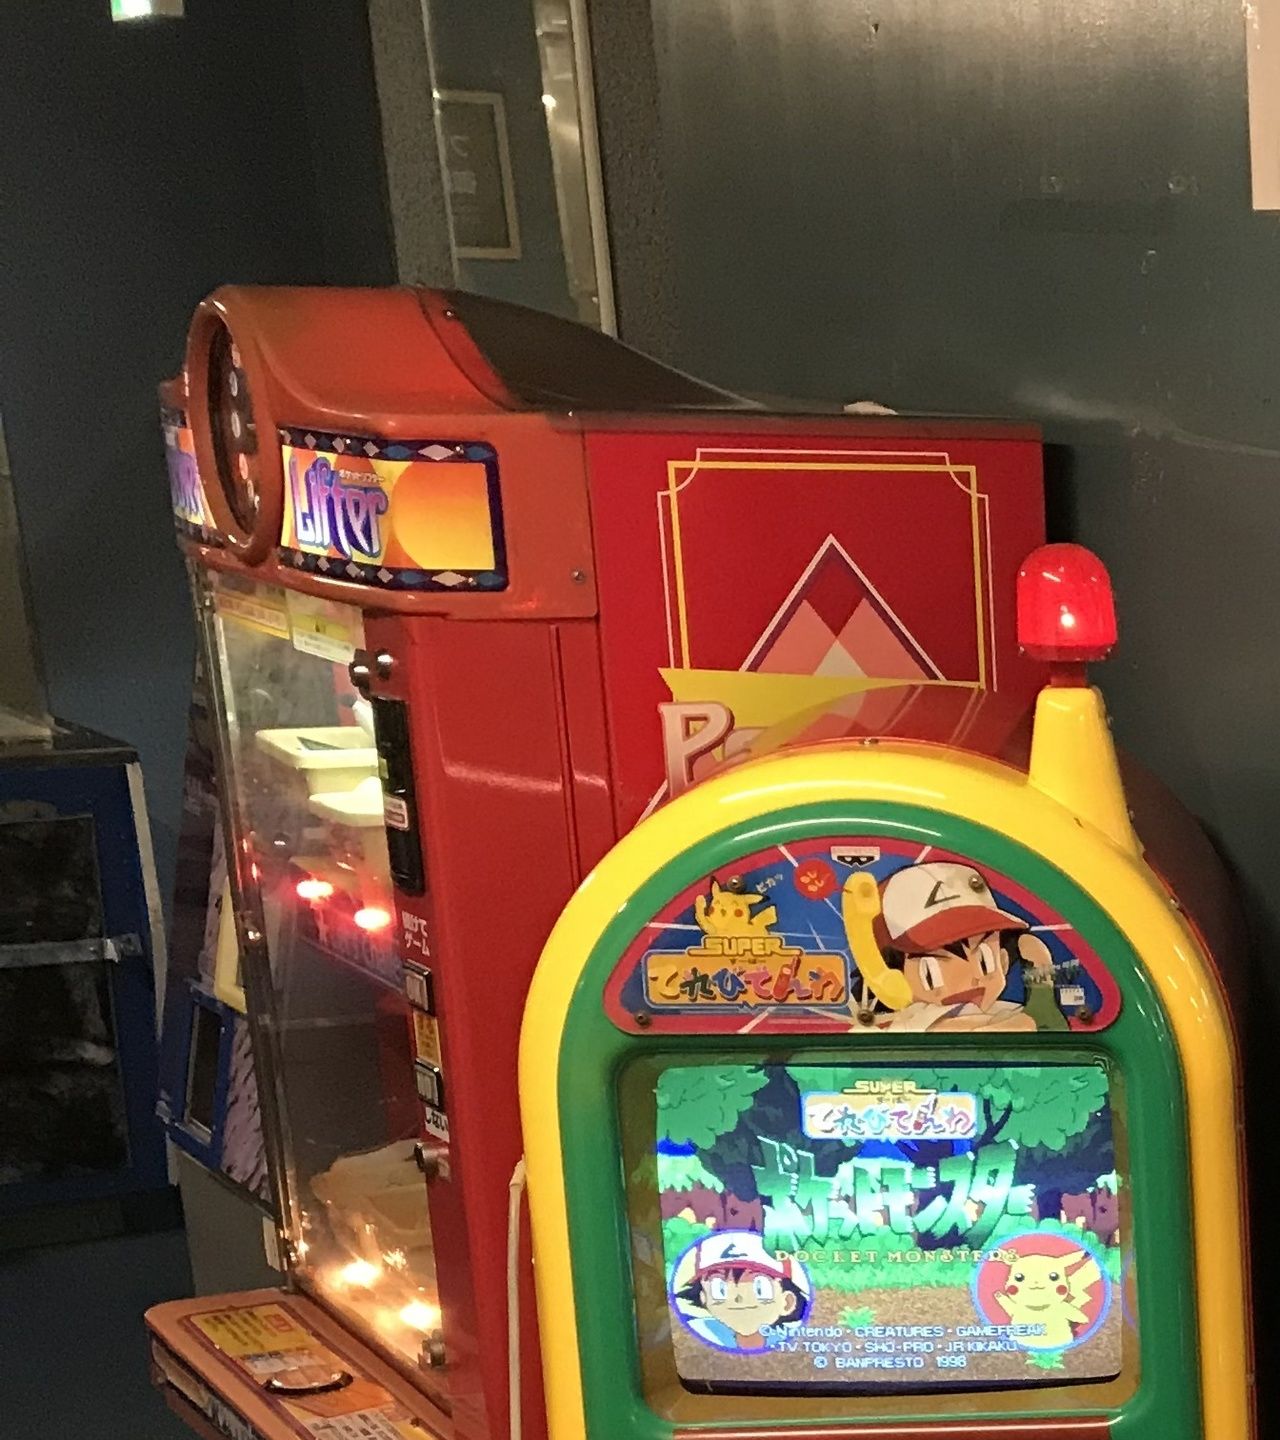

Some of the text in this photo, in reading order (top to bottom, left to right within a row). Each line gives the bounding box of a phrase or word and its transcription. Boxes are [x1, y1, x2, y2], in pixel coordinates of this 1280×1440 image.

[289, 457, 388, 560] Lifter
[703, 937, 784, 955] SUPER
[775, 1249, 878, 1264] POCKET
[854, 1326, 944, 1338] CREATURES
[835, 1356, 925, 1369] BANPRESTO
